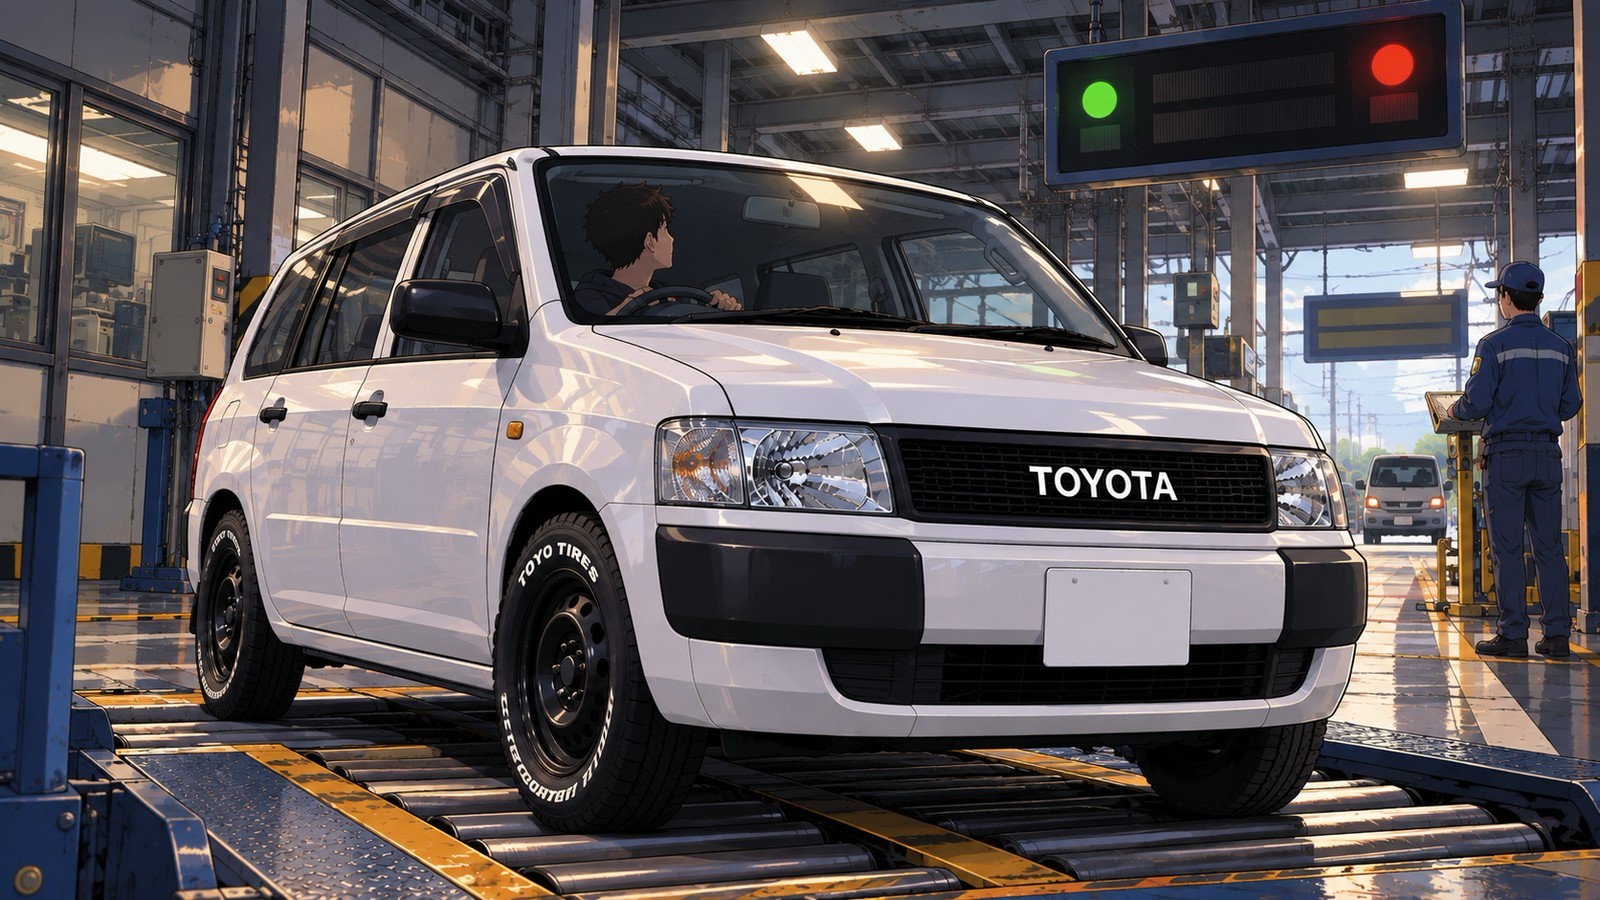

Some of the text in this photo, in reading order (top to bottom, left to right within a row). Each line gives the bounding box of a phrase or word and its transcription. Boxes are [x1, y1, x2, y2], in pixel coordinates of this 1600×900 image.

[1028, 465, 1178, 501] TOYOTA
[517, 542, 599, 587] TOYO TIRES
